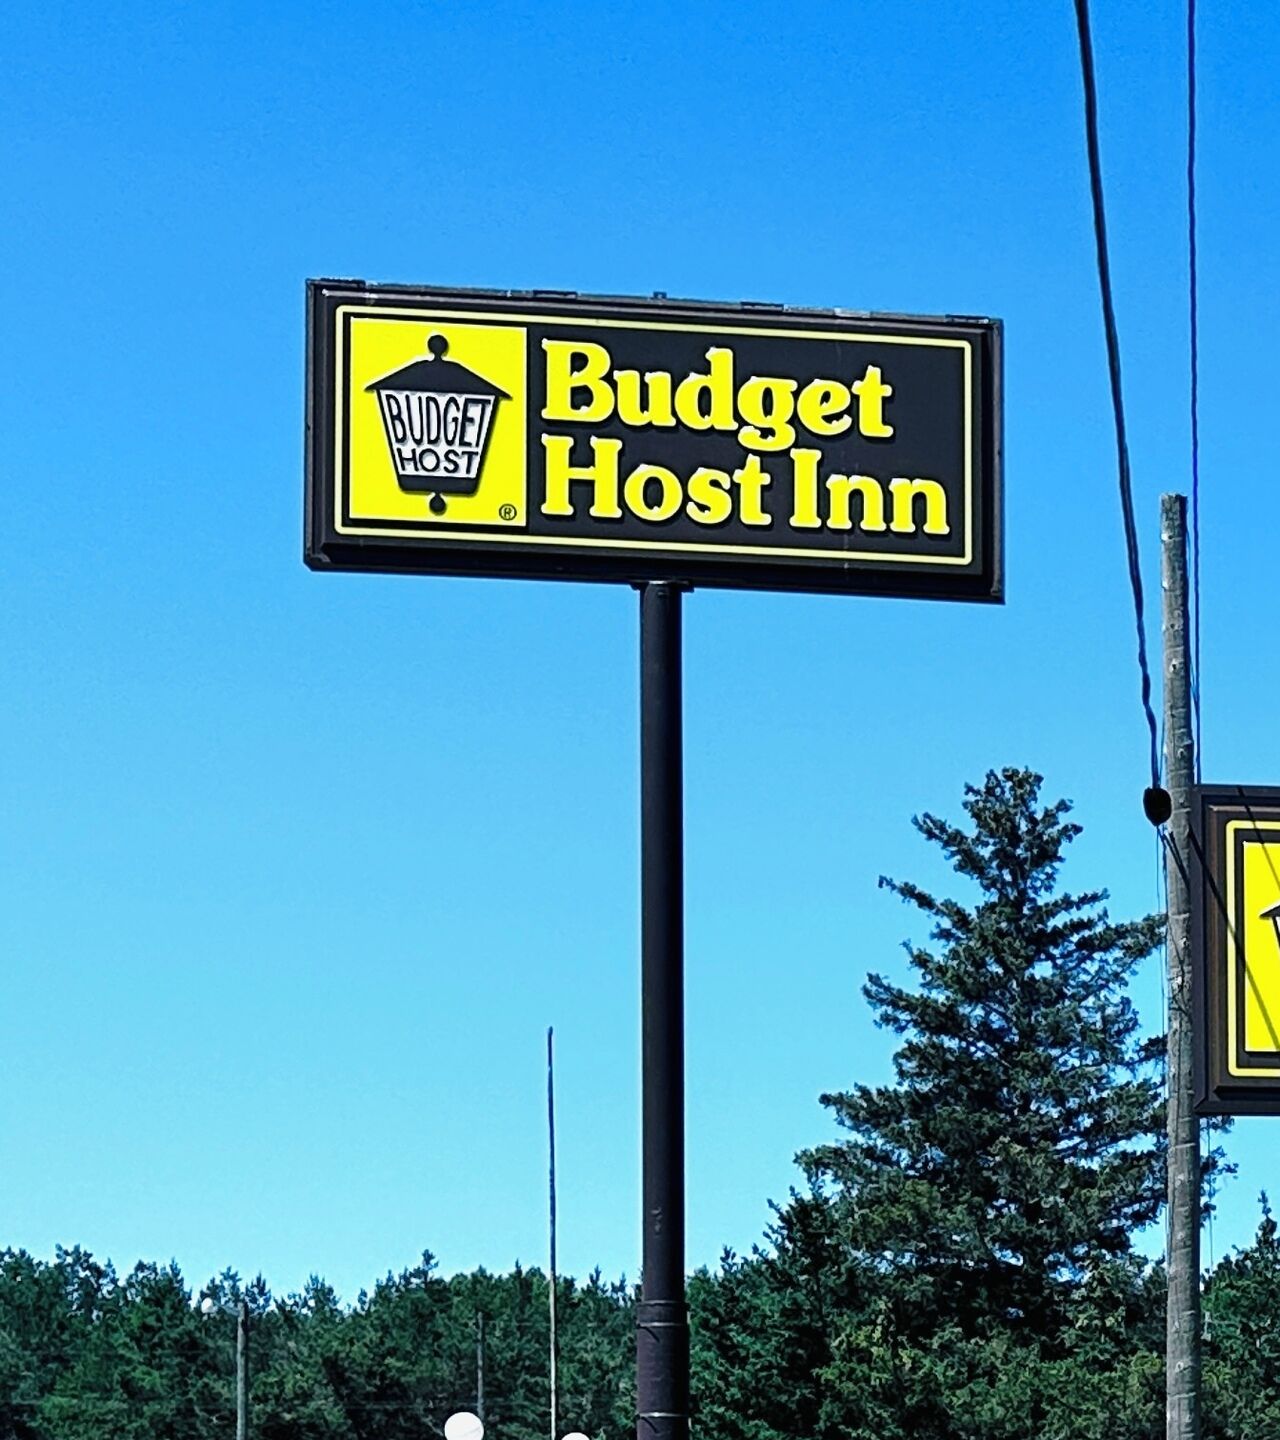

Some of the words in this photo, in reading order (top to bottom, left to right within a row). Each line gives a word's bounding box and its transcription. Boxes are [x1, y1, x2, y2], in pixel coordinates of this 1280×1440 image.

[385, 393, 492, 448] BUDGET
[541, 338, 894, 452] Budget
[396, 447, 479, 475] HOST
[541, 433, 773, 527] Host
[789, 448, 952, 536] Inn
